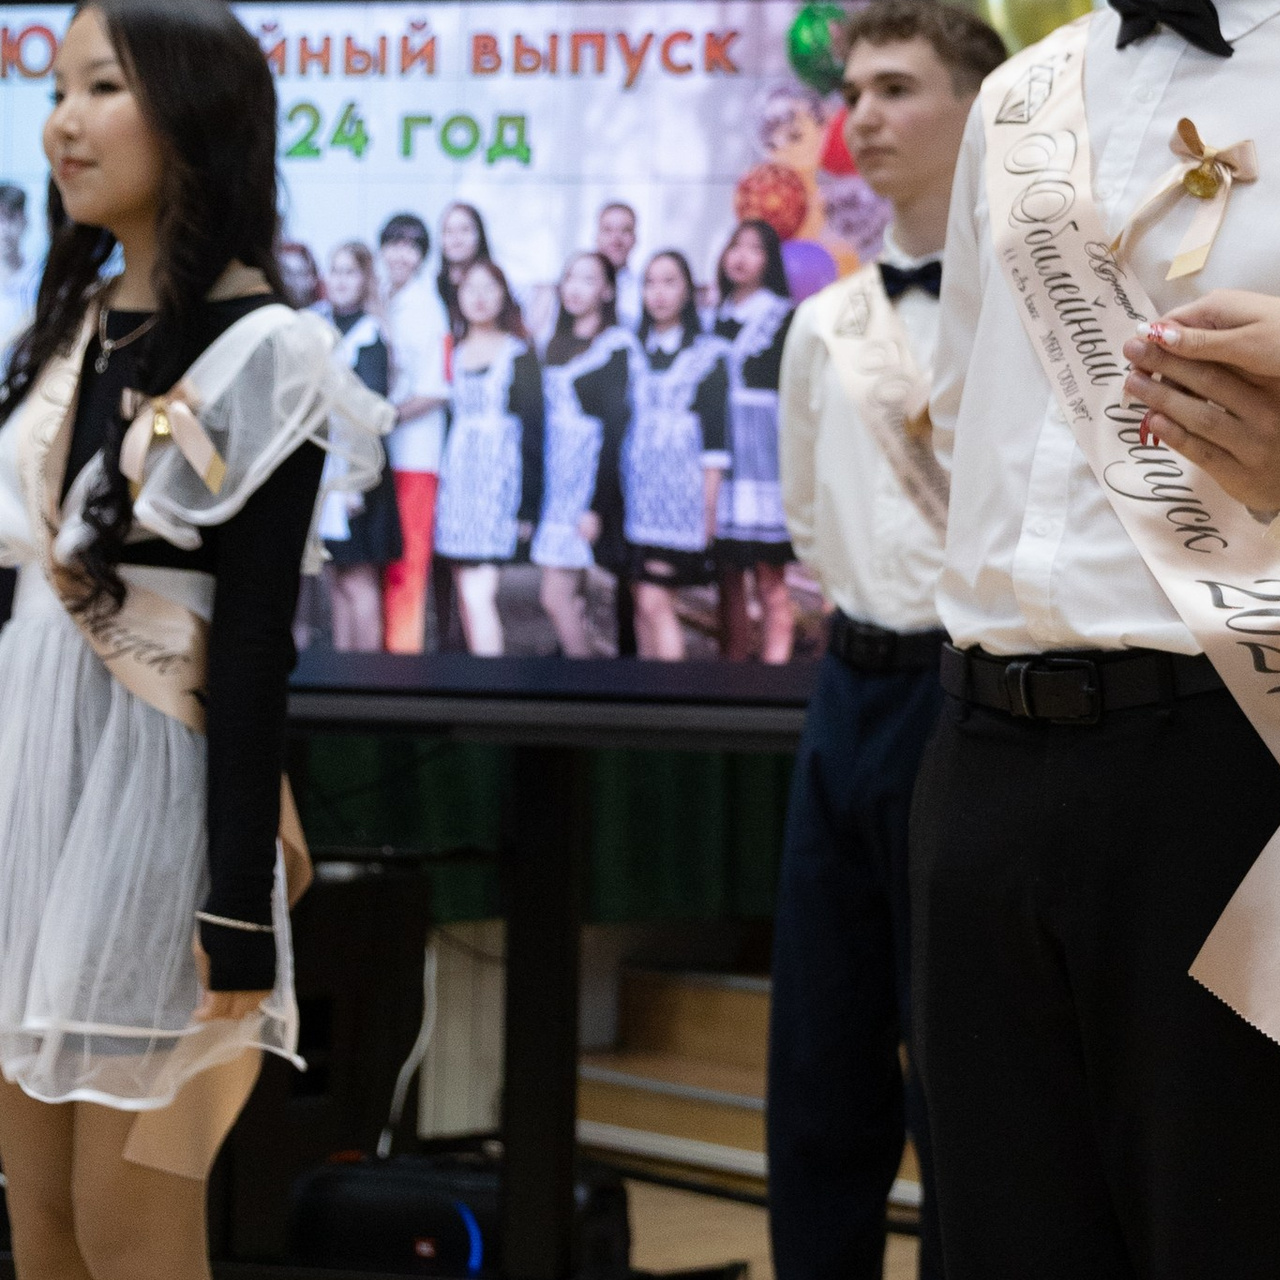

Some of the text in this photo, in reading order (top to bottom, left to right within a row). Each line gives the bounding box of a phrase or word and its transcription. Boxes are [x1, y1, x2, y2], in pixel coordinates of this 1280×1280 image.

[0, 21, 437, 79] Юйный
[286, 103, 531, 164] 24 год
[1004, 129, 1132, 387] Юбилейный
